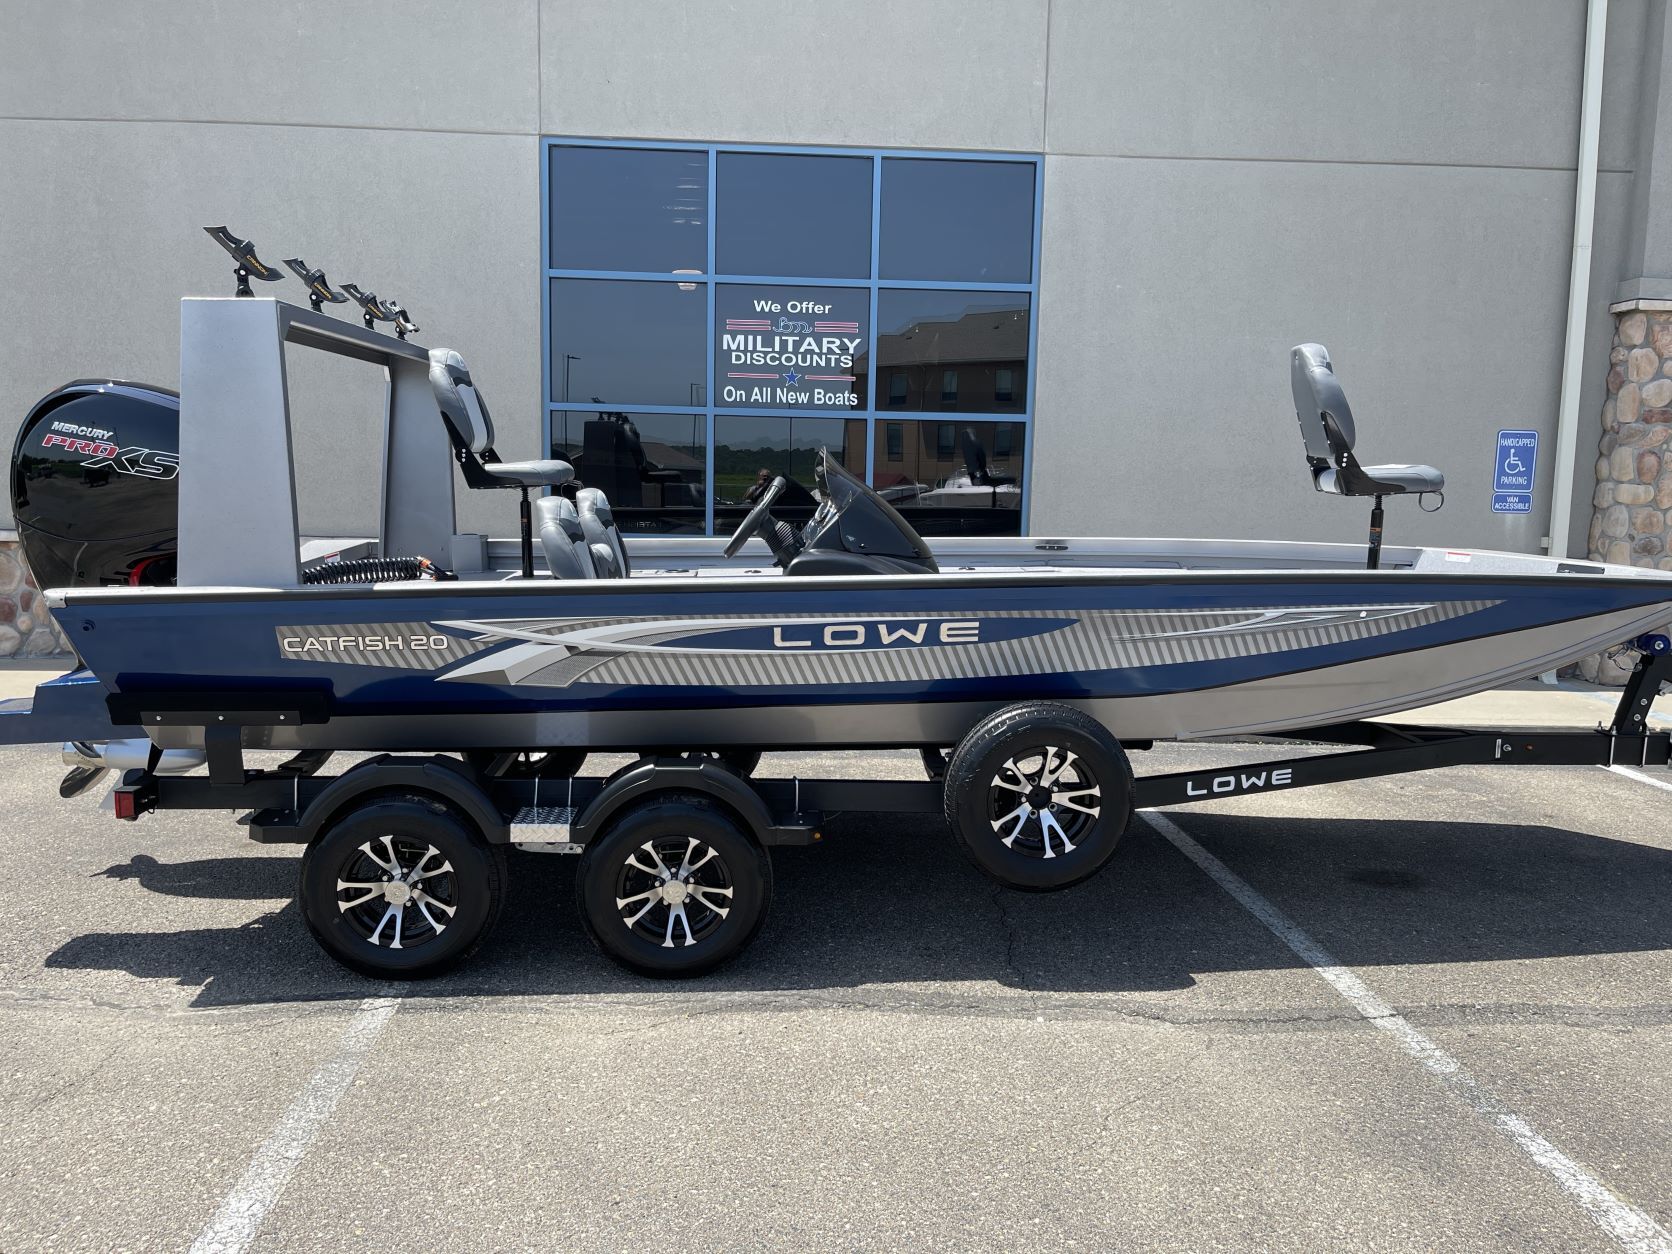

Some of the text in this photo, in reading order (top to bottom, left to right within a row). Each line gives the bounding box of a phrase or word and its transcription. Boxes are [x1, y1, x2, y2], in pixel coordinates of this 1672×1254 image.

[754, 300, 832, 314] We Offer
[722, 334, 862, 354] MILITARY
[731, 352, 853, 368] DISCOUNTS
[723, 386, 858, 406] On All New Boats
[51, 421, 114, 440] MERCURY
[1500, 438, 1535, 447] HANDICAPPED
[42, 433, 180, 480] PRO XS
[1500, 476, 1527, 484] PARKING
[1494, 502, 1530, 510] ACCESSIBLE
[773, 621, 980, 648] LOWE
[283, 635, 449, 653] CATFISH 20
[1186, 768, 1293, 796] LOWE
